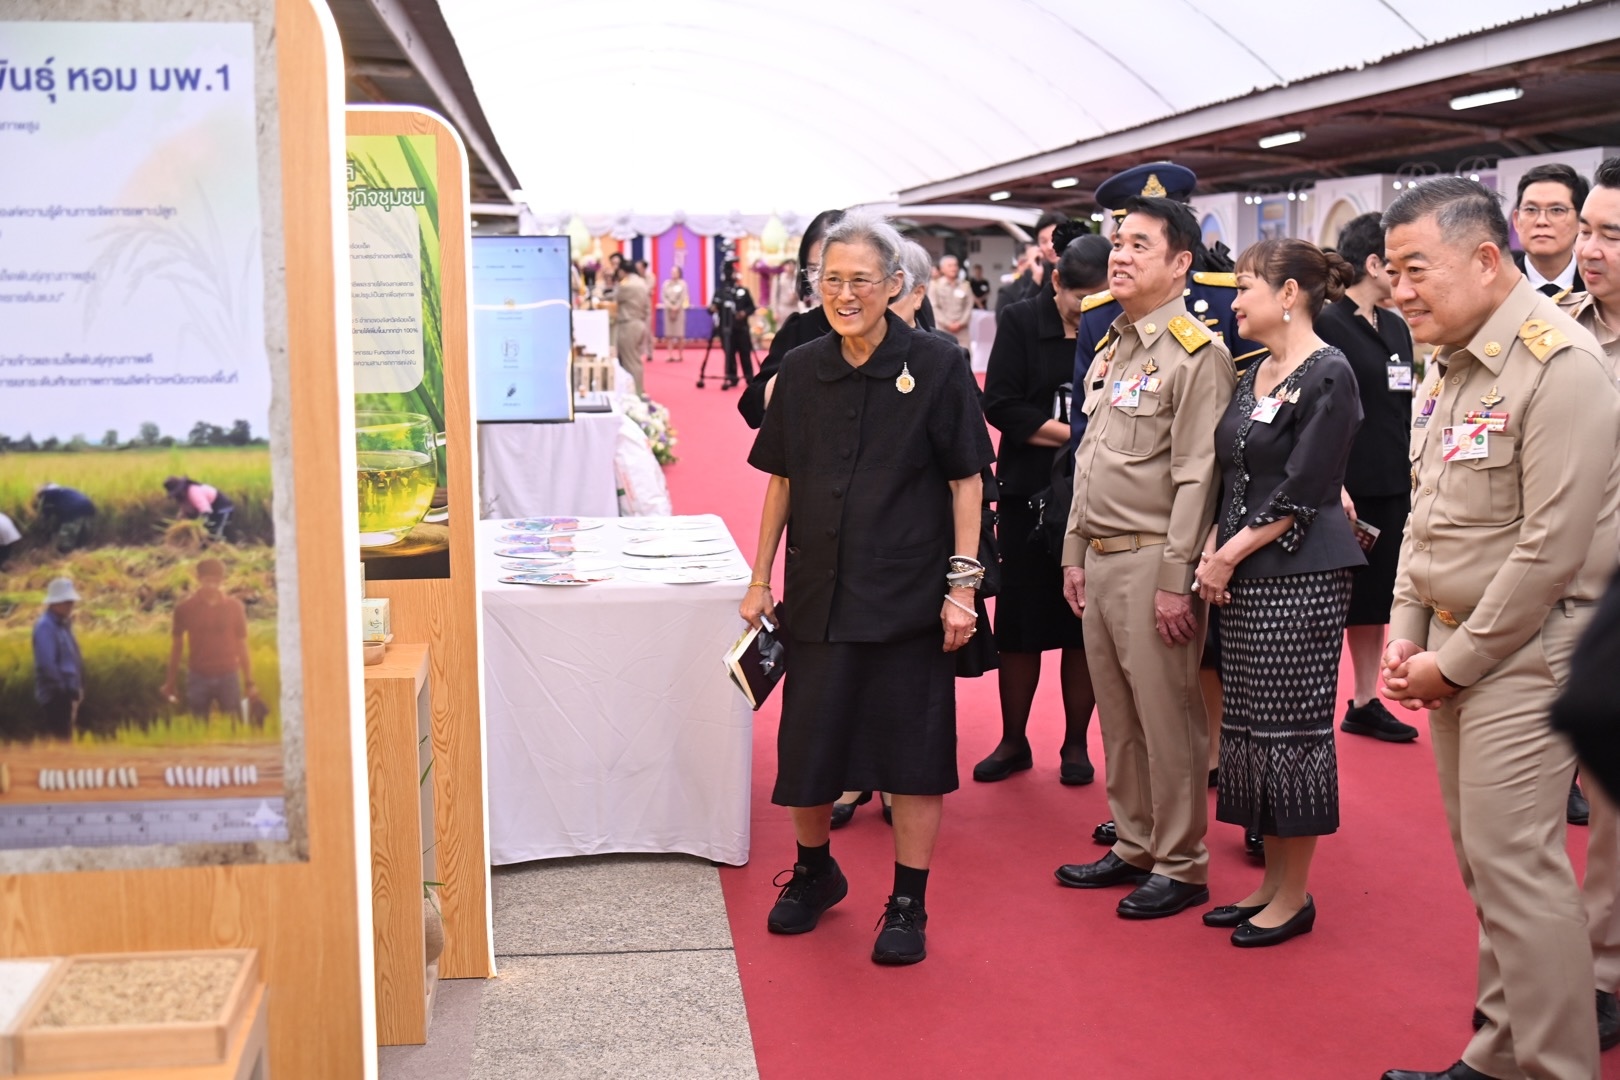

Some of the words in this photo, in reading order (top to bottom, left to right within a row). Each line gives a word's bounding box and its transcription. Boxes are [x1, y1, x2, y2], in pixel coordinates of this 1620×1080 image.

[0, 57, 55, 103] ันธุ์
[67, 67, 137, 91] หอม
[150, 64, 230, 91] มพ.1
